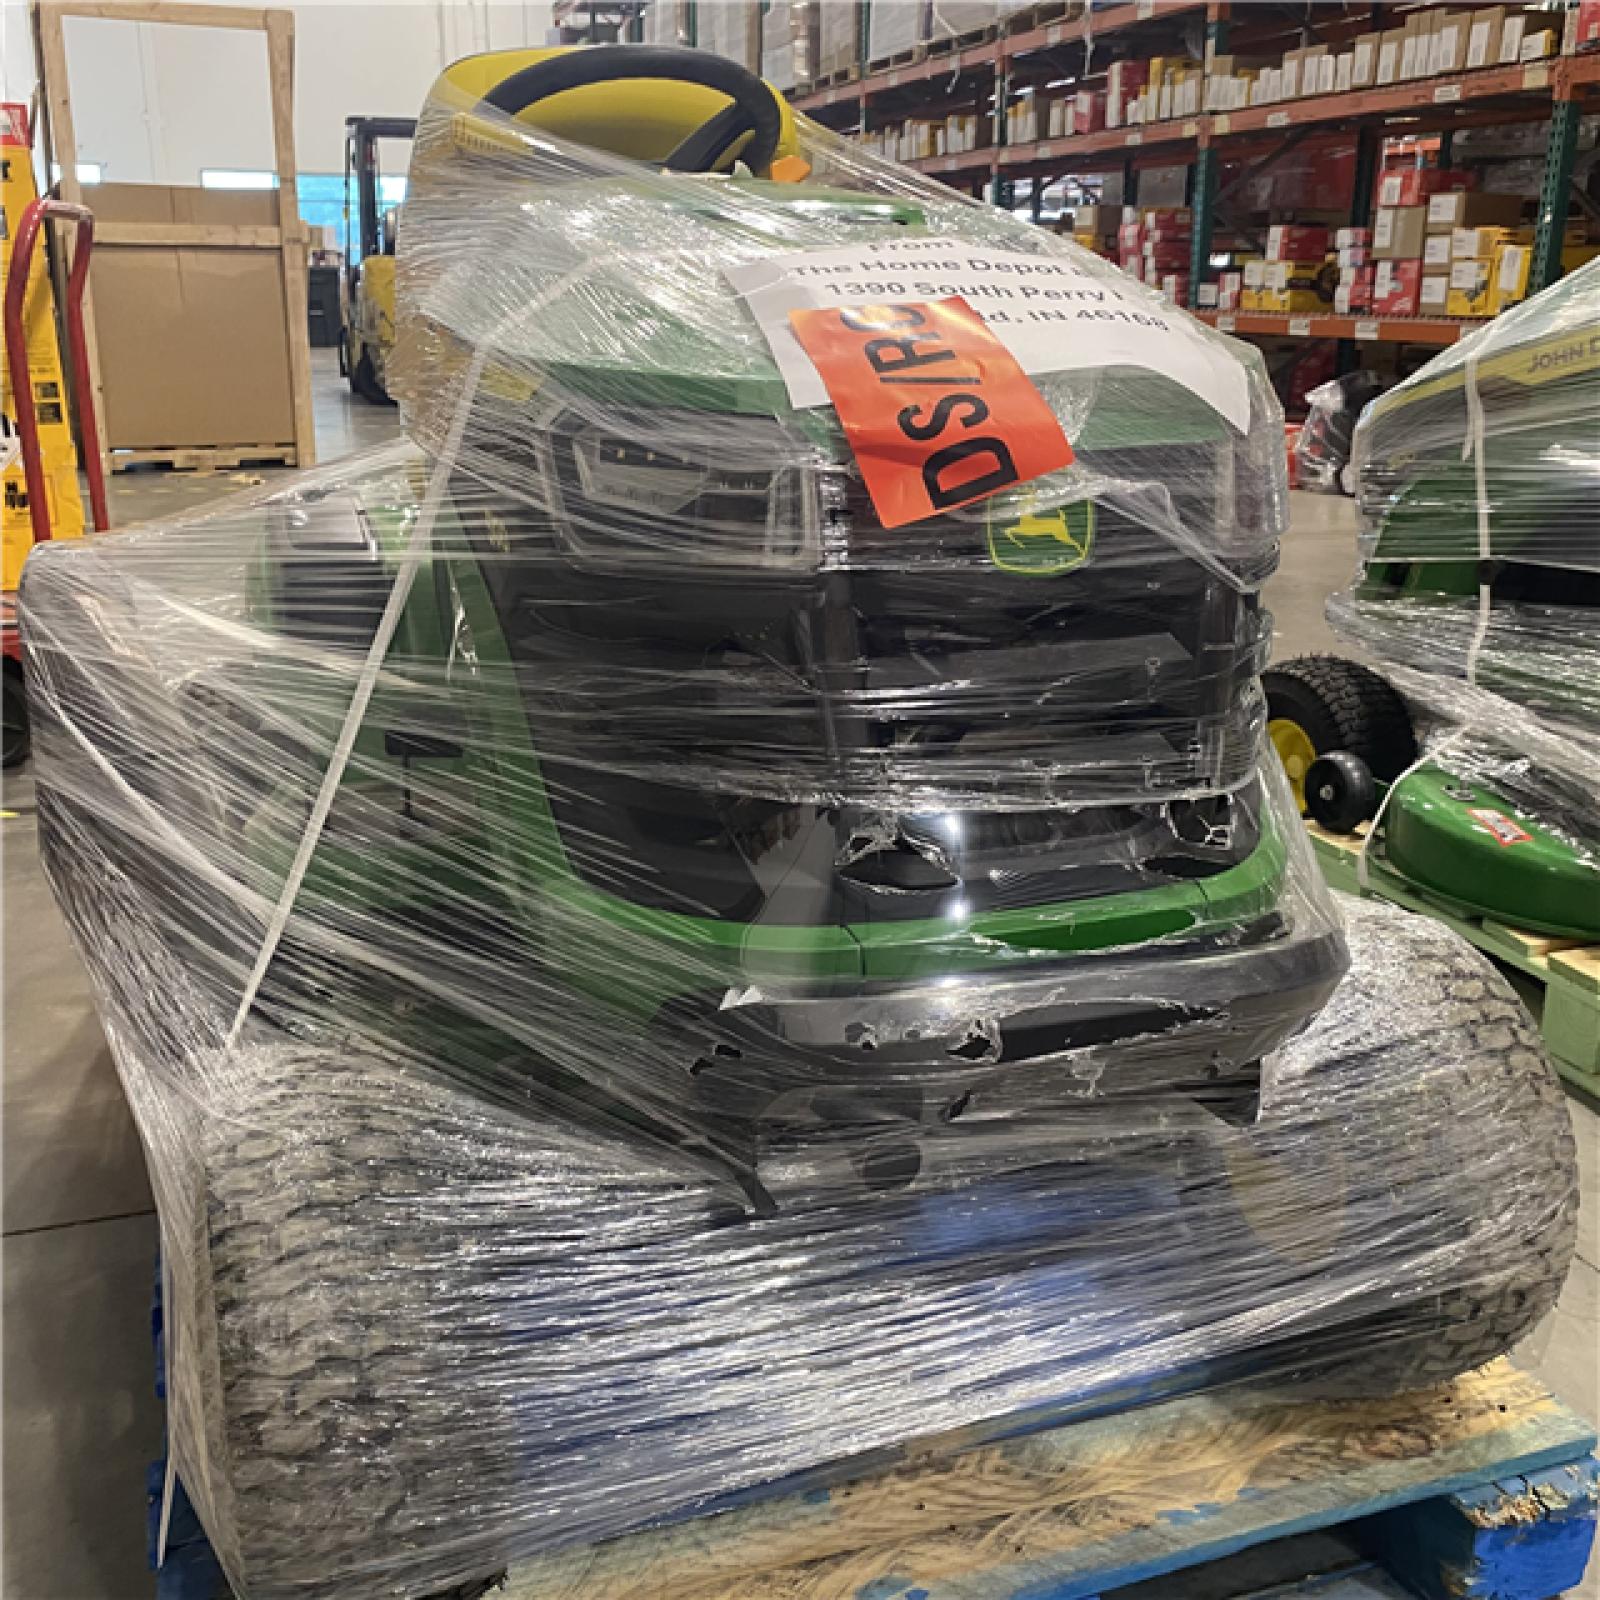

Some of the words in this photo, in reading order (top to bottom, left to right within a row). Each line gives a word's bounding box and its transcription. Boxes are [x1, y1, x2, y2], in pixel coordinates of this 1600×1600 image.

[789, 264, 853, 276] The
[859, 259, 960, 271] Home
[967, 259, 1066, 275] Depot
[825, 282, 905, 296] 1390
[913, 282, 1014, 298] South
[1020, 286, 1105, 301] Perry
[1027, 310, 1069, 322] IN
[1528, 342, 1584, 373] JOHN
